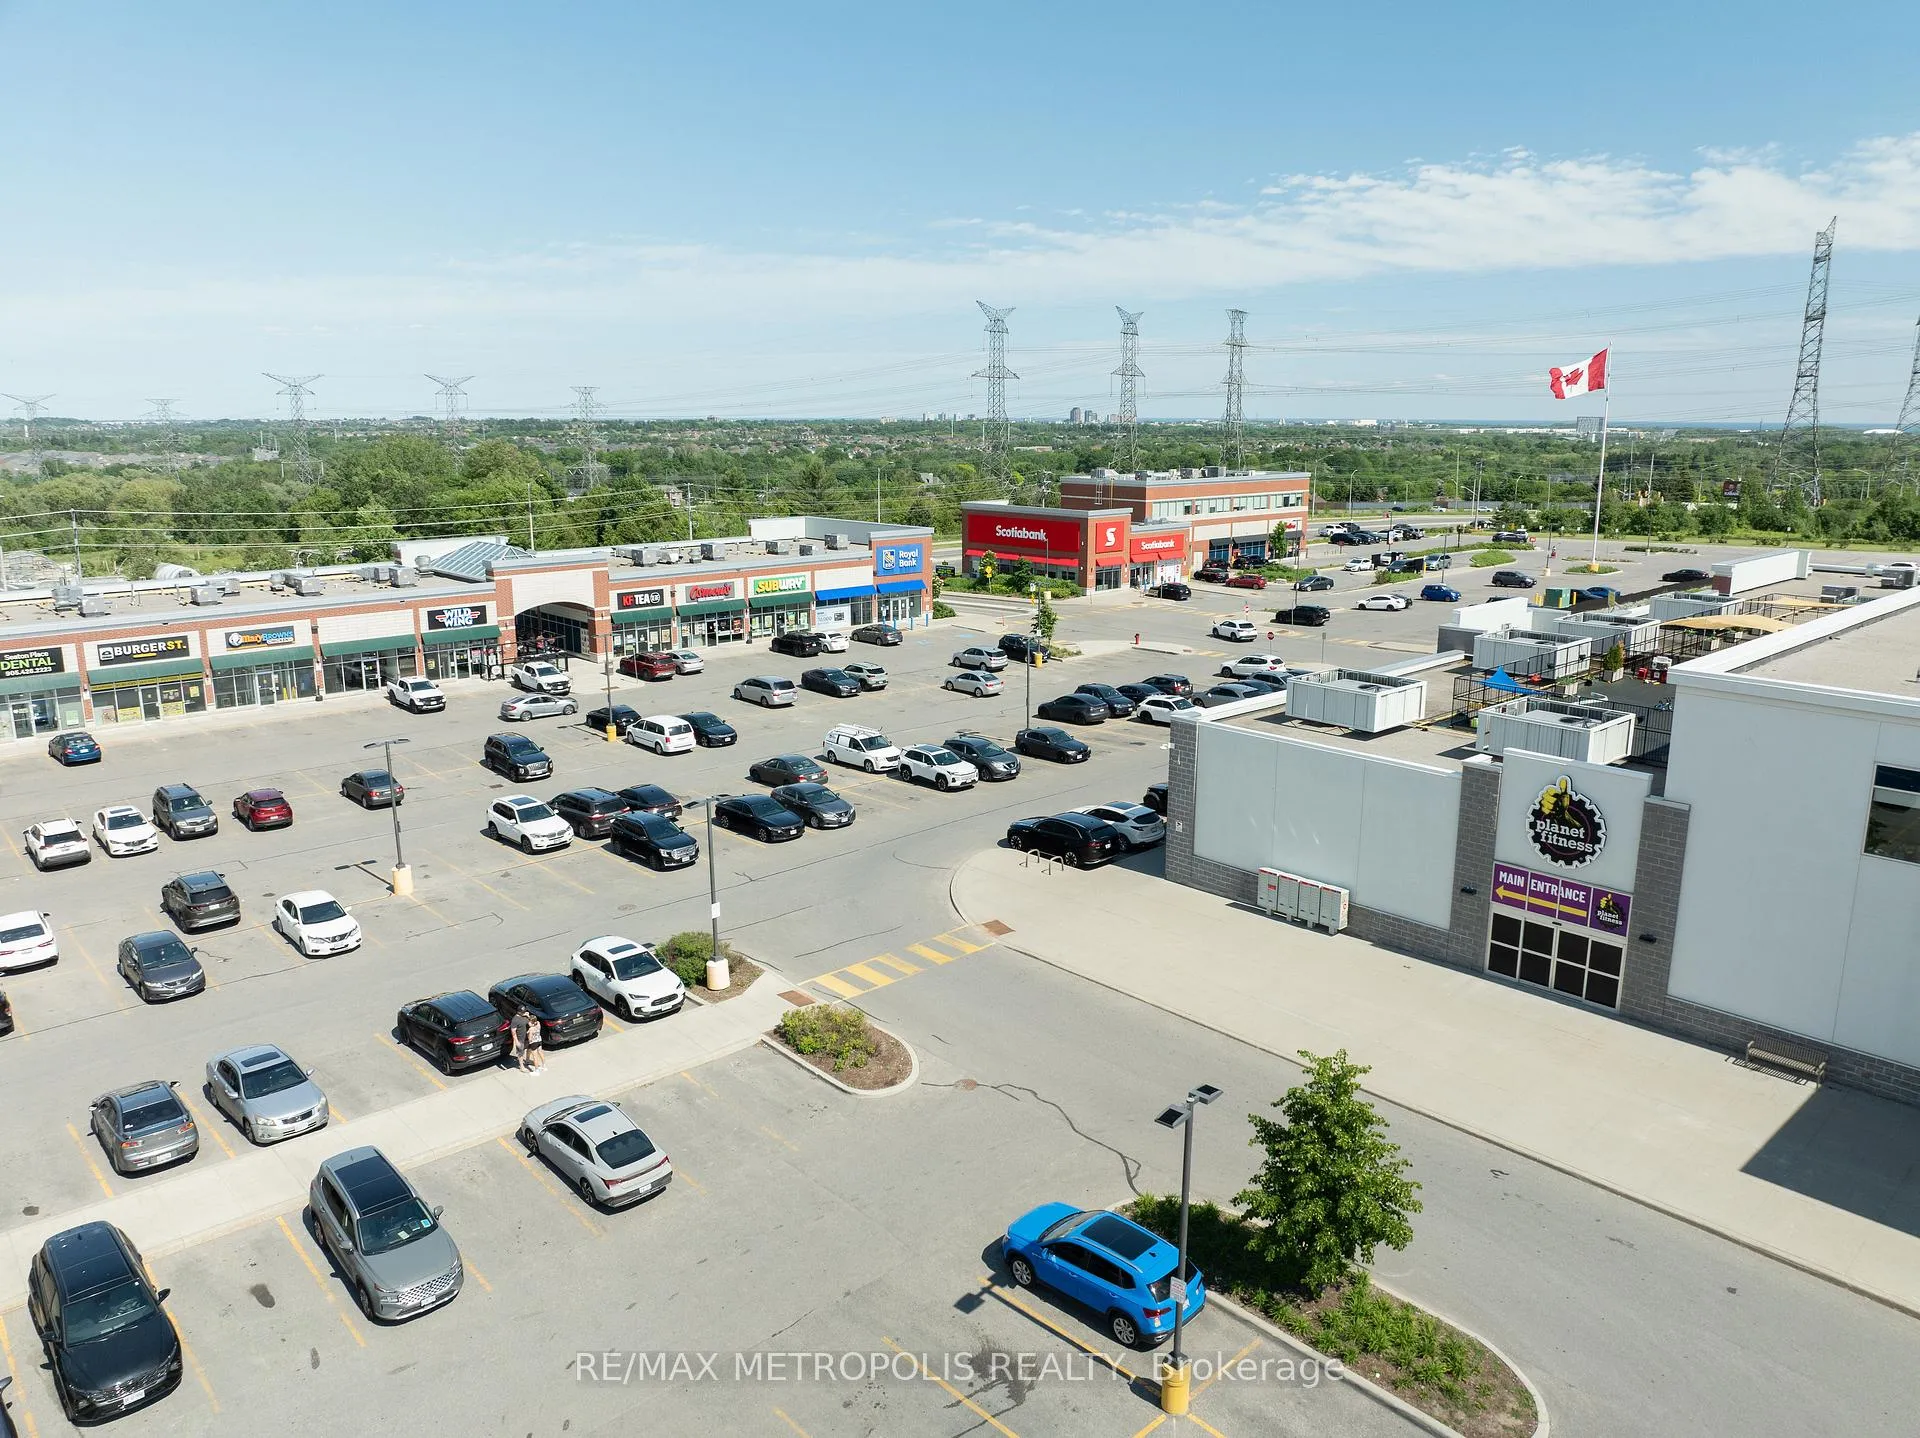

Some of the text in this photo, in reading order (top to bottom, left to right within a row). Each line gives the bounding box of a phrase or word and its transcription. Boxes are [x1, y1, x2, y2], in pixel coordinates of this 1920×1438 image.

[995, 525, 1047, 541] Scotiabank
[1141, 540, 1175, 551] Scotiabank
[899, 549, 919, 560] Royal
[899, 558, 917, 567] Bank
[756, 577, 805, 594] SUBWAY
[634, 594, 650, 605] TEA
[443, 608, 472, 618] WILD
[444, 615, 473, 627] WING
[0, 657, 56, 671] DENTAL
[1535, 819, 1585, 839] planet
[1540, 830, 1594, 853] fitness
[1499, 871, 1586, 903] MAIN ENTRANCE
[1597, 910, 1619, 919] planet
